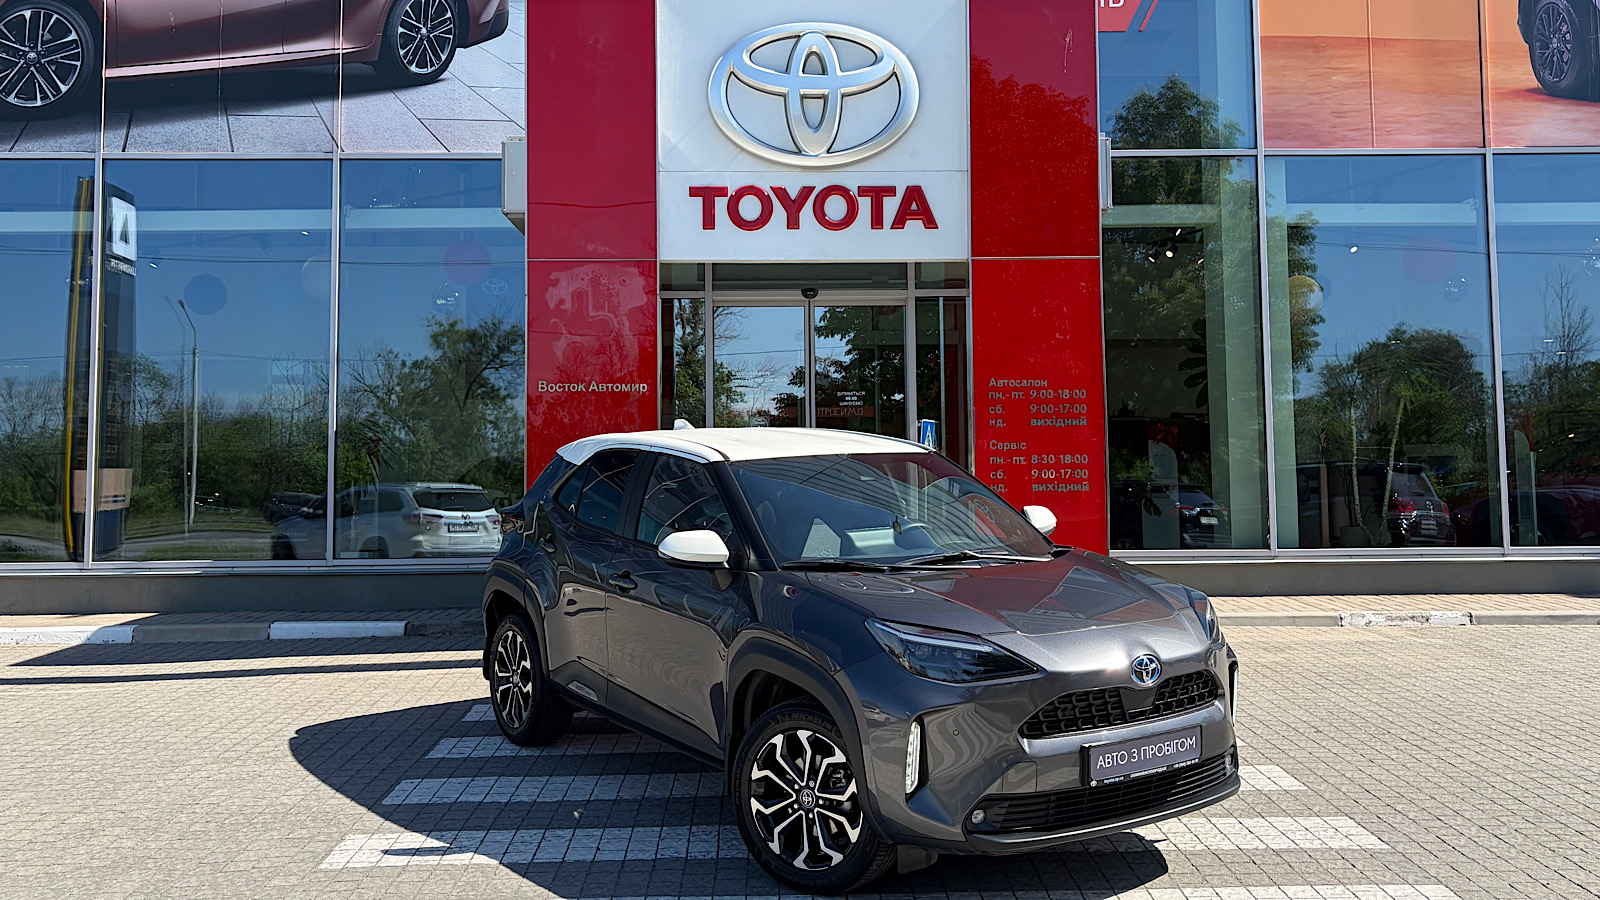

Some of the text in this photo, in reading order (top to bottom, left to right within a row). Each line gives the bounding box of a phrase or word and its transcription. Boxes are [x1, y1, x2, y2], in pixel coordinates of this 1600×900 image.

[689, 185, 939, 231] TOYOTA
[538, 381, 648, 395] Восток Автомир
[988, 378, 1048, 387] Автосалон
[1029, 389, 1087, 399] 9:00-18:00
[988, 404, 1088, 414] сб. 9:00-17:00
[989, 416, 1088, 428] нд. вихідний
[989, 440, 1027, 452] Сервіс
[990, 469, 1089, 479] сб. 9:00-17:00
[1032, 481, 1090, 493] вихідний
[1096, 751, 1128, 769] АВТО
[1140, 736, 1196, 760] ПРОБІГОМ
